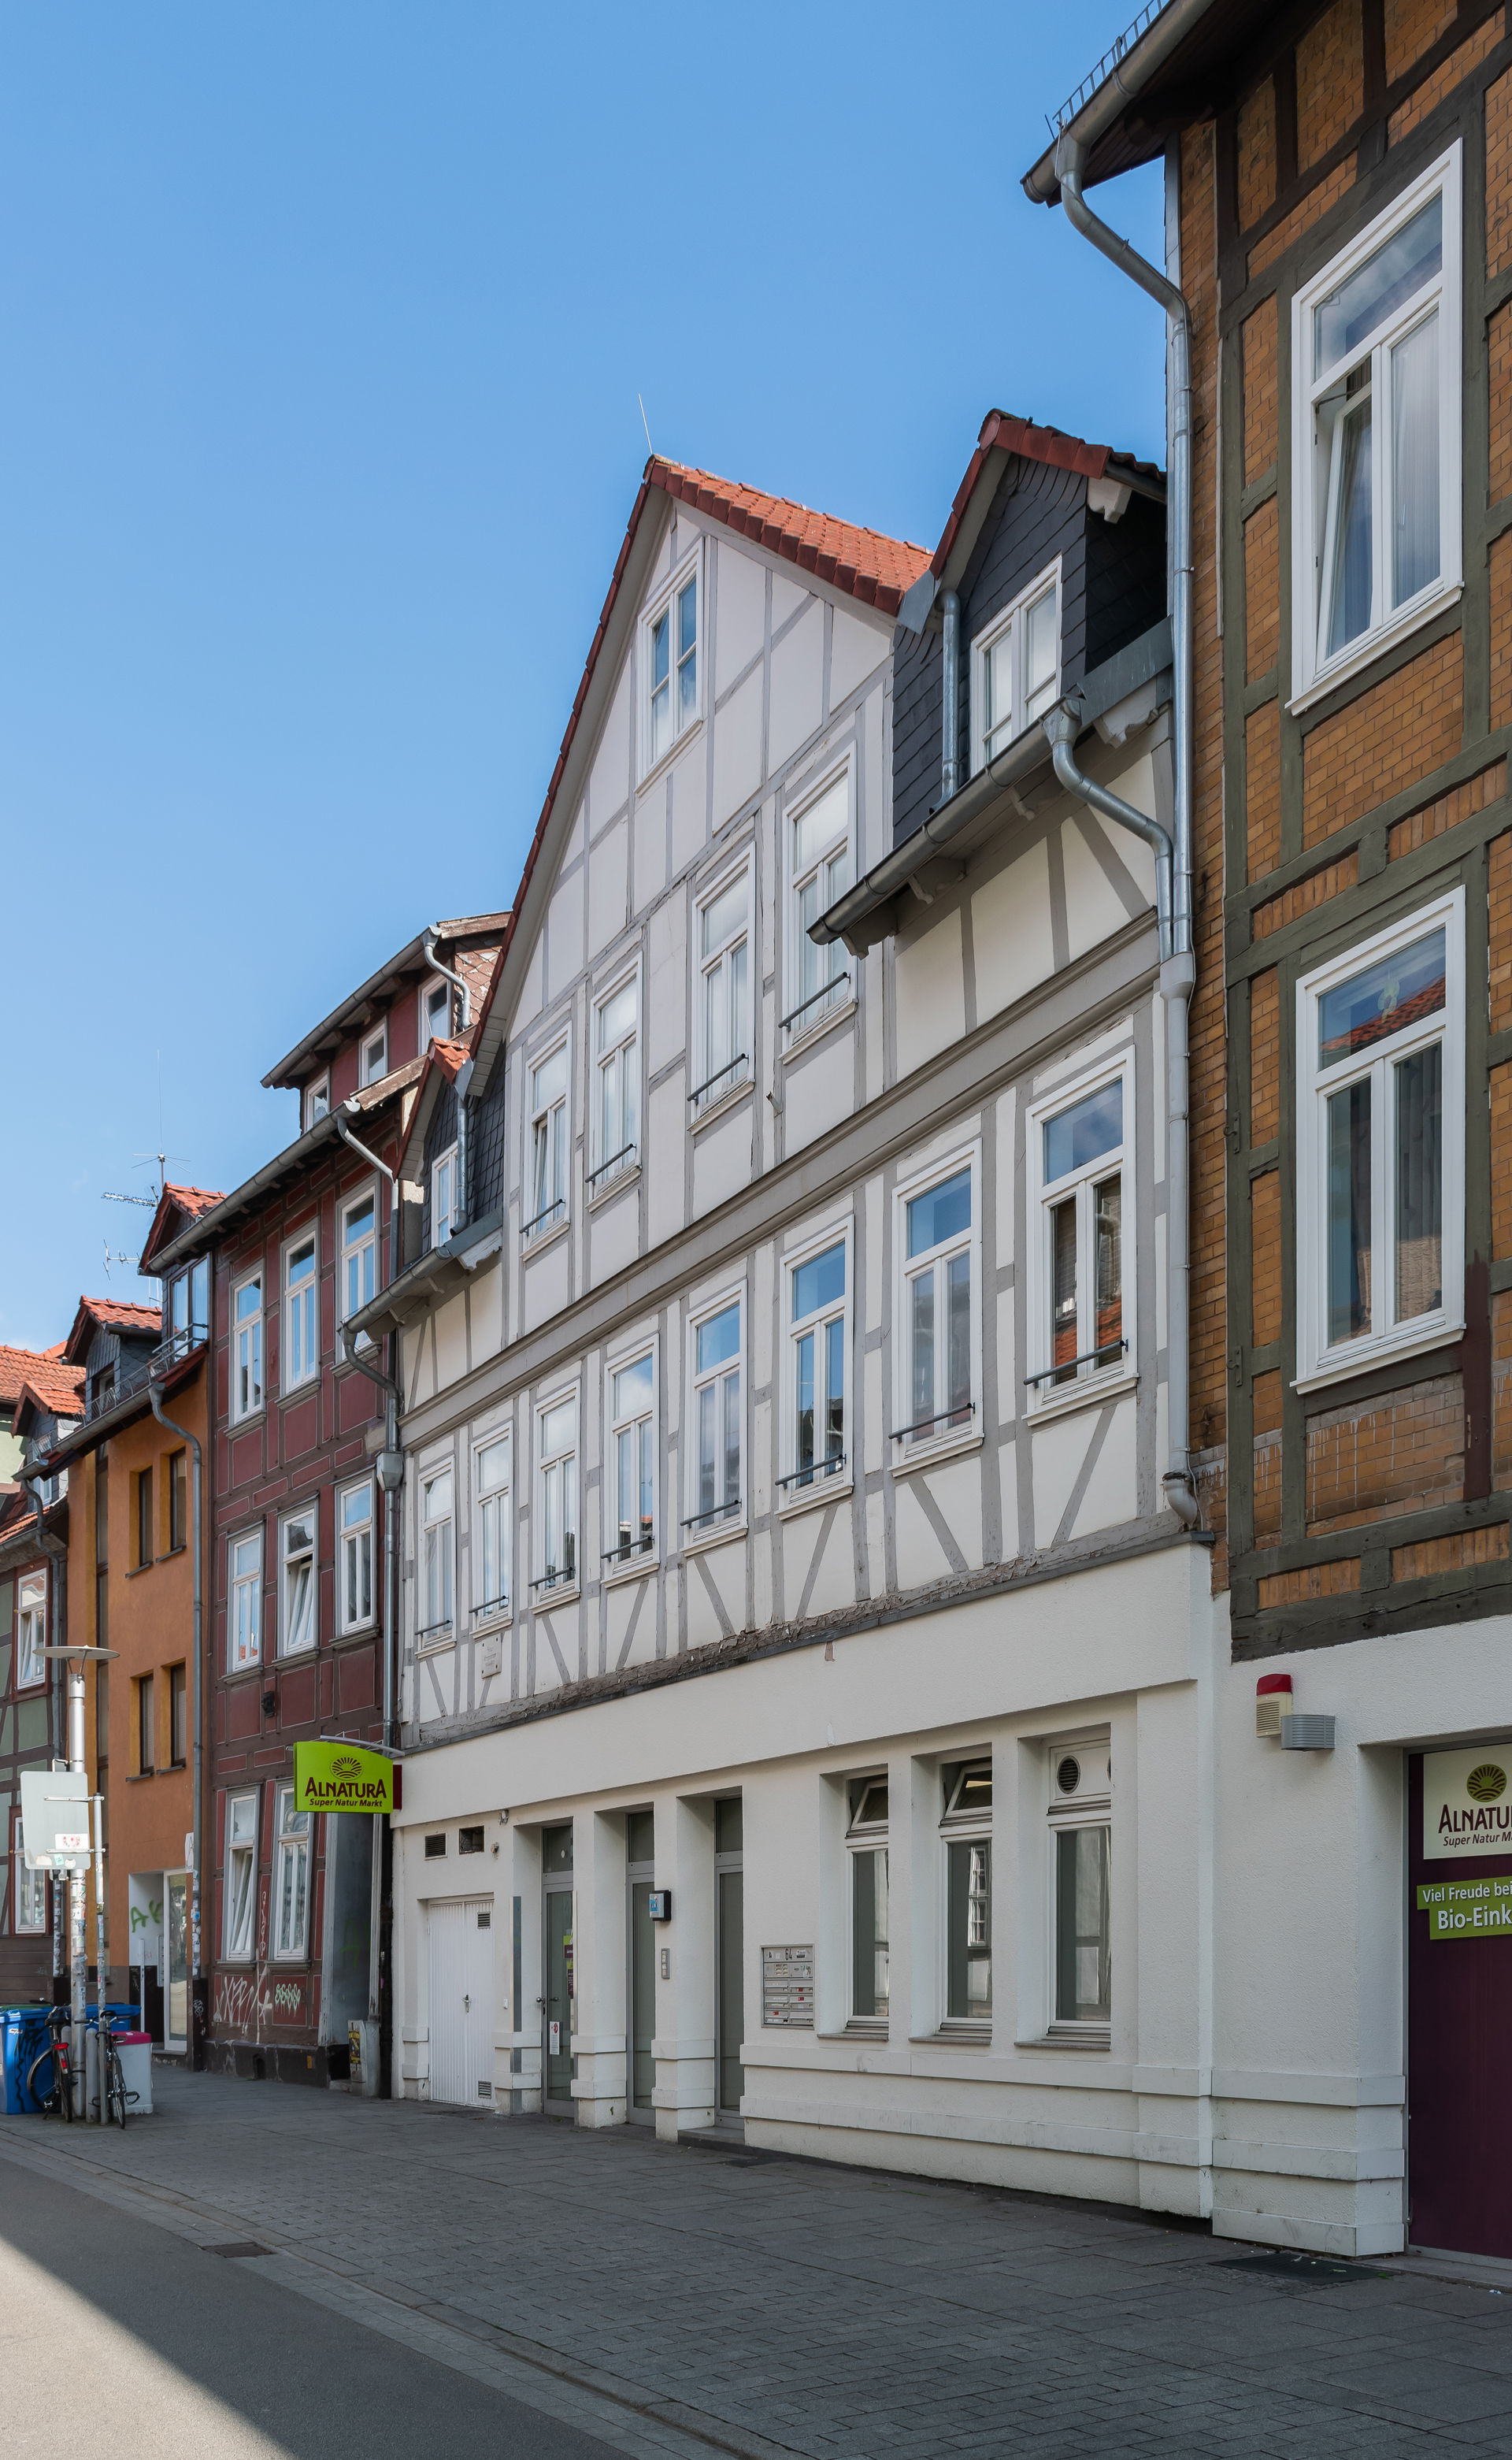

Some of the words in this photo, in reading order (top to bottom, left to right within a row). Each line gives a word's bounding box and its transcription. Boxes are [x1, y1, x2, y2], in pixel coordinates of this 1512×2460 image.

[305, 1776, 387, 1798] ALNATURA
[309, 1798, 334, 1807] Super
[1438, 1804, 1512, 1834] ALNATU
[1443, 1835, 1471, 1848] Super
[1472, 1833, 1499, 1844] Natur
[1501, 1831, 1512, 1842] M
[1422, 1887, 1445, 1903] Viel
[1448, 1883, 1491, 1901] Freude
[785, 1948, 793, 1961] 64
